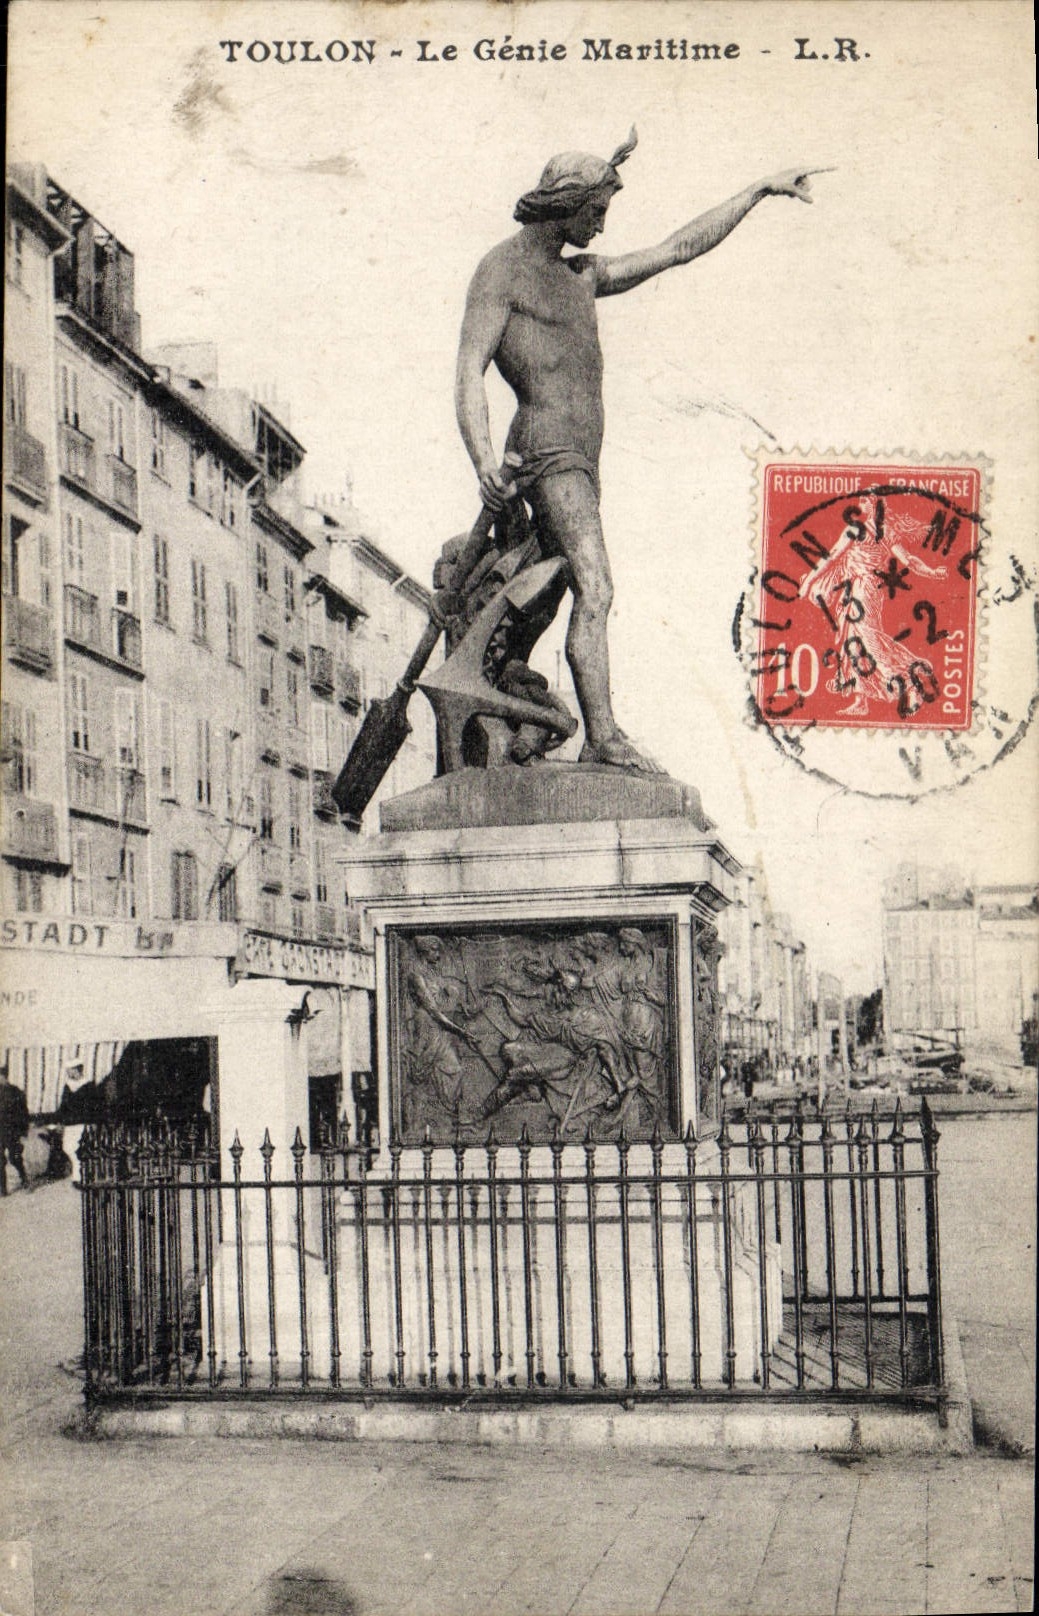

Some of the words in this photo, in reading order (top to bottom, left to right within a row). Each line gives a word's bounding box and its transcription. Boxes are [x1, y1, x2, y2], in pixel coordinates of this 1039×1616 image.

[773, 474, 861, 494] REPUBLIQUE
[769, 642, 820, 698] 10
[943, 629, 965, 715] POSTES
[1, 919, 110, 948] STADT
